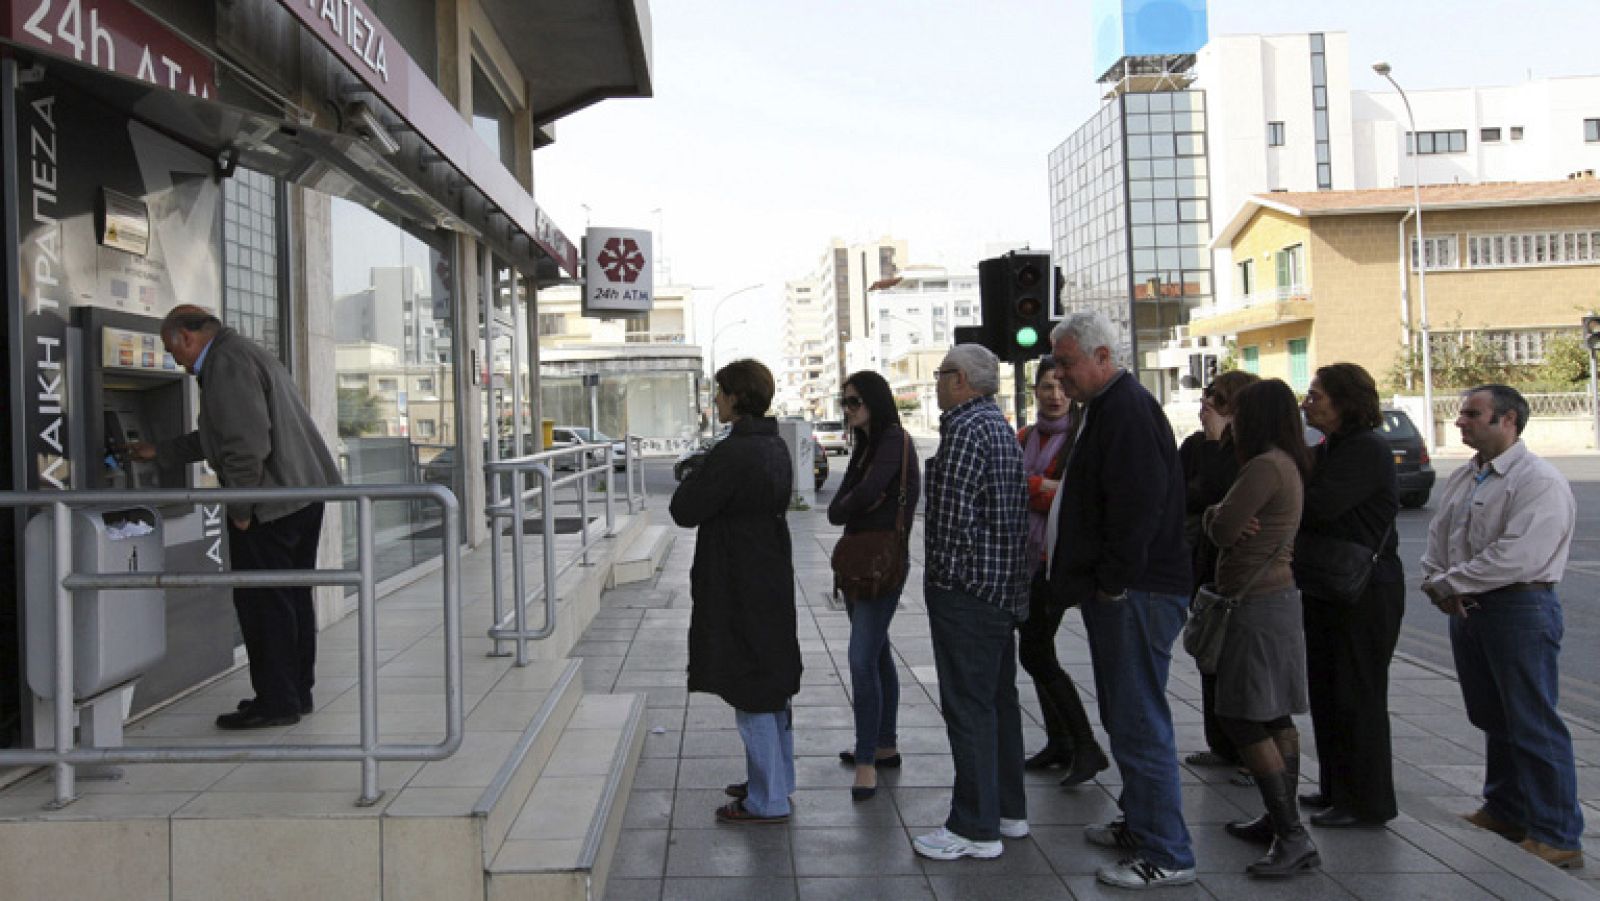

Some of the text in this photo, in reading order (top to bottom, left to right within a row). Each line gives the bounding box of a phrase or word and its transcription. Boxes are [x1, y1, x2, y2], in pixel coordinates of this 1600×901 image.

[23, 0, 115, 71] 24h
[309, 0, 388, 82] ΑΠΕΖΑ
[31, 96, 61, 316] ΤΡΑΠΕΖΑ
[204, 502, 224, 572] ΑΙΚ
